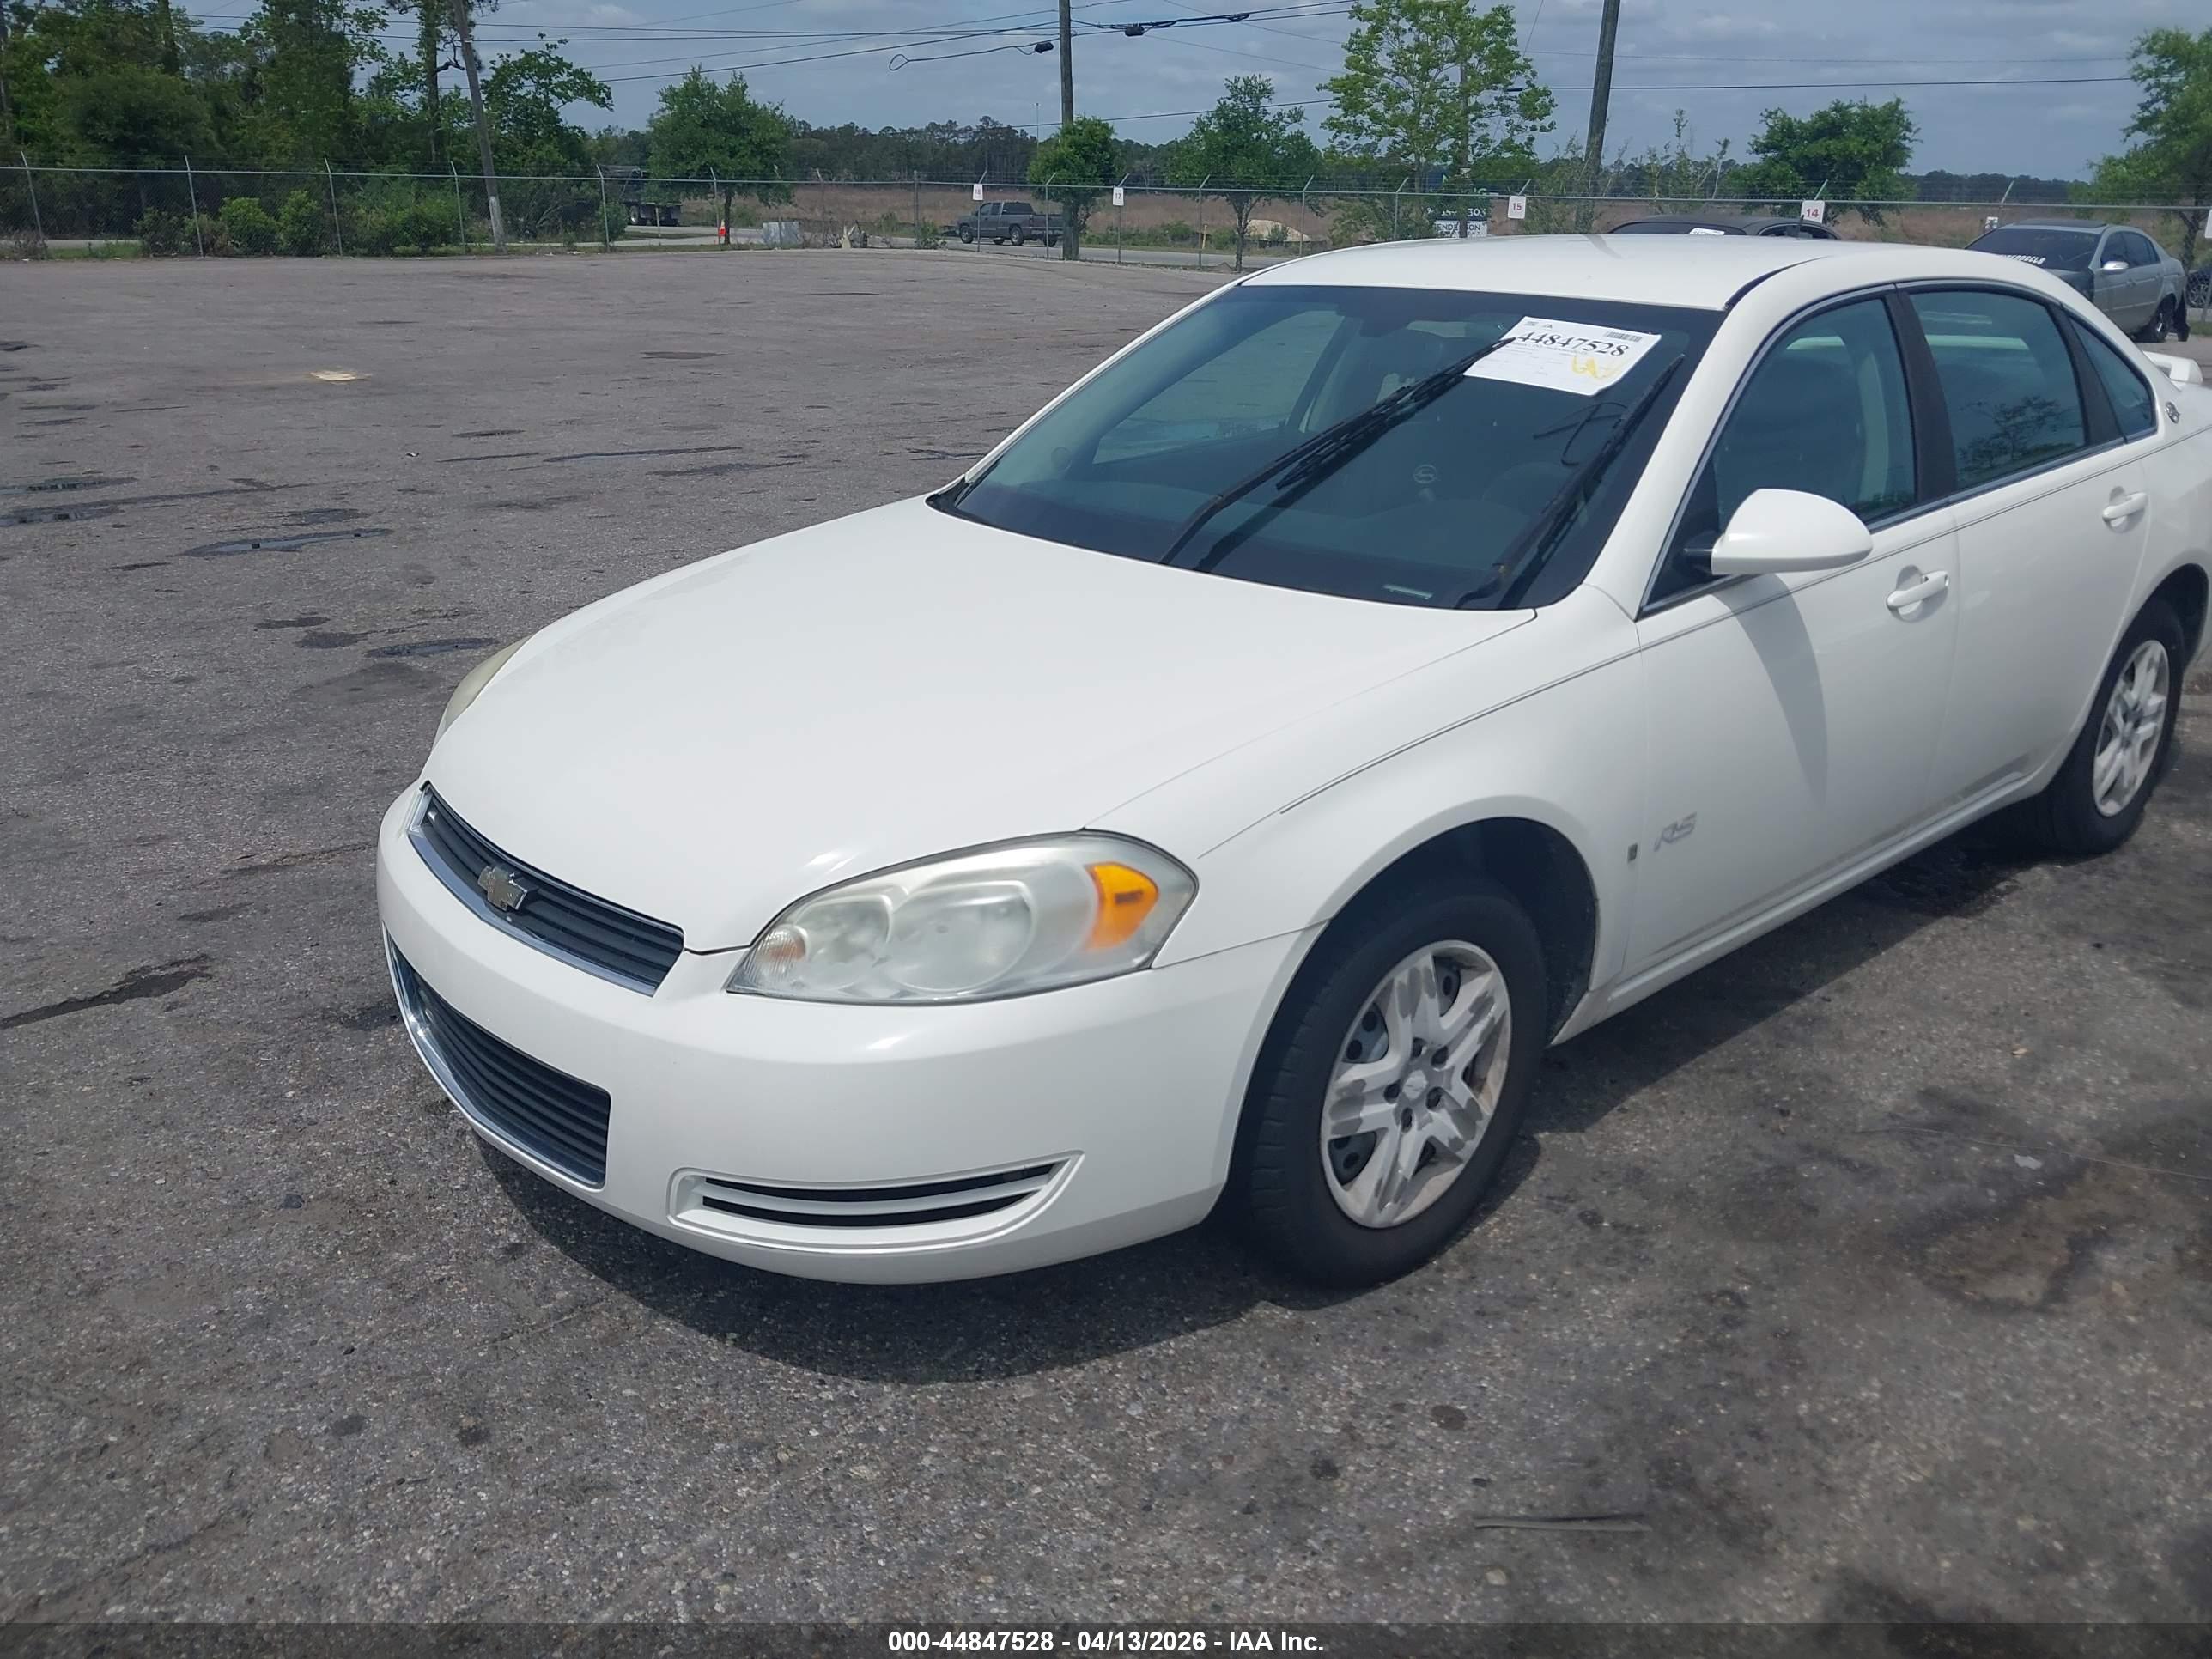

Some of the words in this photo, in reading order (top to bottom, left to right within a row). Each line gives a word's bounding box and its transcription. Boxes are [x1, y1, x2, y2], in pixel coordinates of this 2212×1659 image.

[1512, 203, 1522, 211] 15
[1806, 208, 1820, 218] 14
[1517, 331, 1630, 357] 44847528
[1653, 811, 1698, 853] RS
